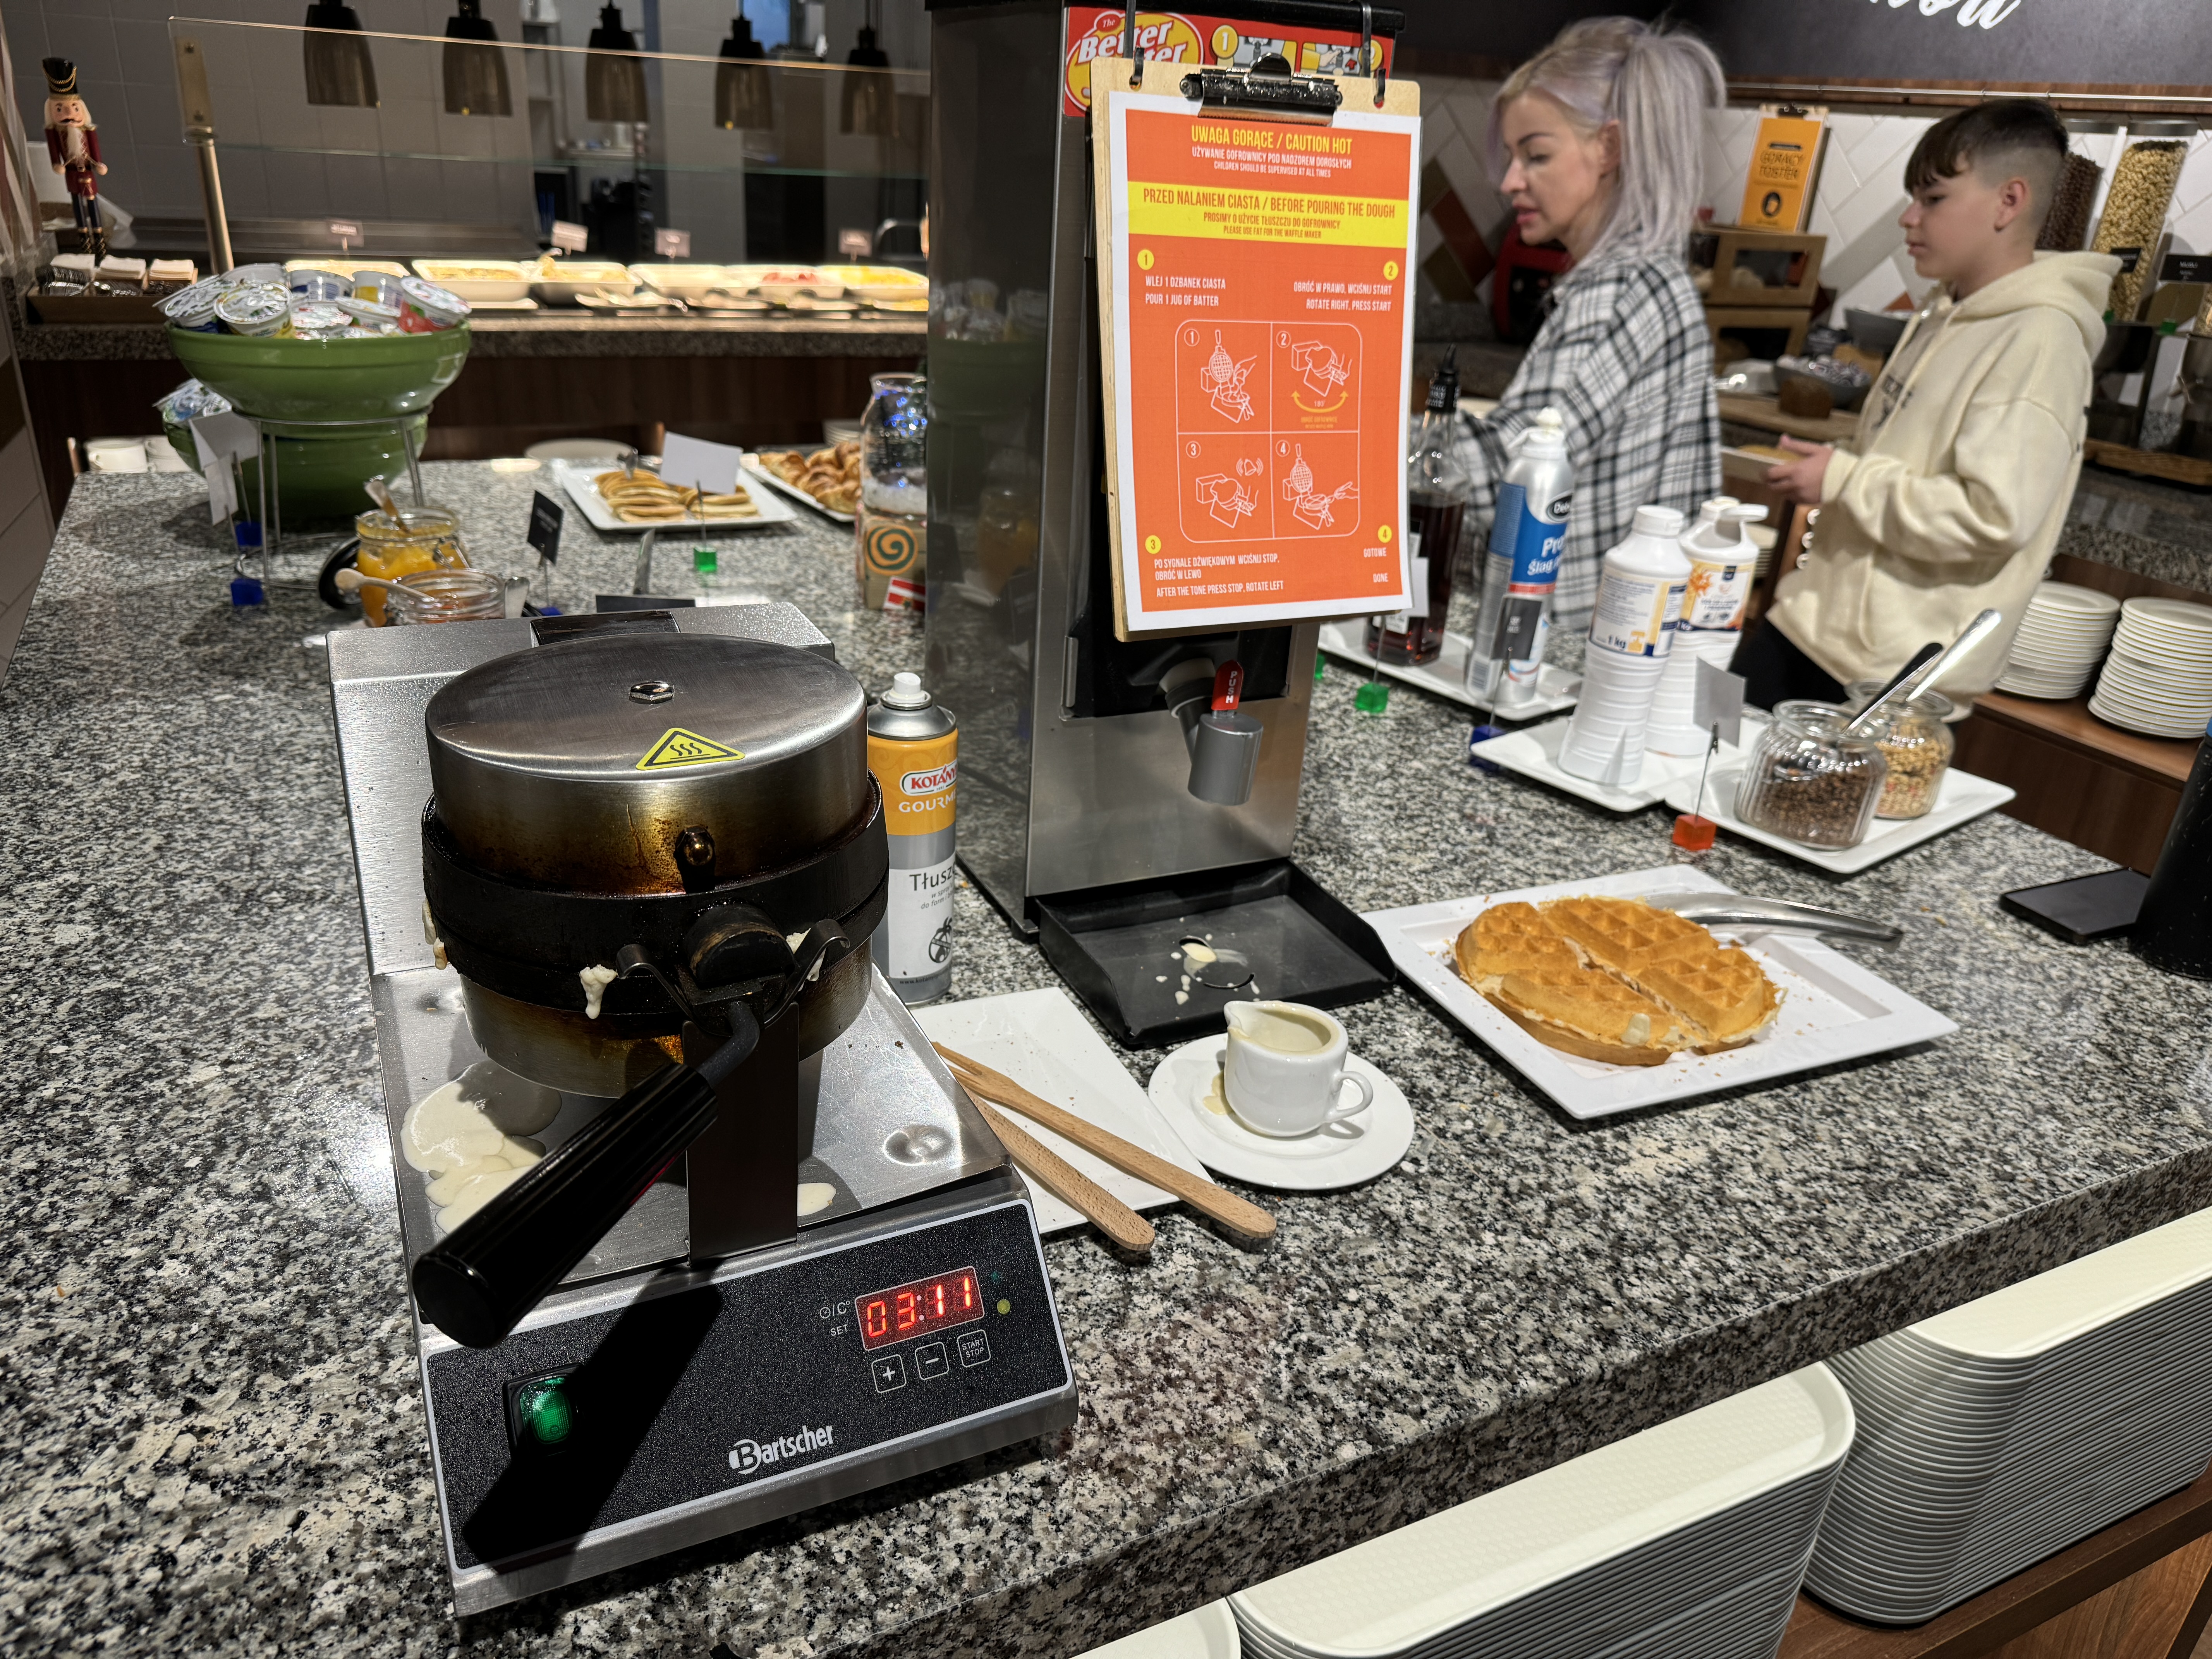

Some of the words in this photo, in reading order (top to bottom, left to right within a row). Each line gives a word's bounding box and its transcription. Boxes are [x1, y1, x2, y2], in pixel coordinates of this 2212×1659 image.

[1103, 19, 1115, 28] The
[1222, 32, 1229, 51] 1
[1192, 125, 1230, 145] UWAGA
[1233, 129, 1274, 150] GORĄCE
[1286, 133, 1330, 152] CAUTION
[1333, 138, 1352, 155] HOT
[1192, 145, 1225, 160] UŻYWANIE
[1226, 149, 1267, 162] GOFROWNICY
[1268, 153, 1280, 164] POD
[1281, 154, 1315, 166] NADZOREM
[1316, 156, 1352, 169] DOROSŁYCH
[1214, 161, 1239, 171] CHILDREN
[1240, 163, 1259, 172] SHOULD
[1260, 164, 1266, 173] BE
[1268, 165, 1298, 175] SUPERVISED
[1298, 167, 1305, 176] AT
[1305, 168, 1315, 177] ALL
[1316, 168, 1331, 178] TIMES
[1144, 188, 1174, 204] PRZED
[1177, 191, 1225, 208] NALANIEM
[1228, 194, 1259, 210] CIASTA
[1271, 197, 1304, 213] BEFORE
[1307, 199, 1345, 215] POURING
[1347, 202, 1364, 216] THE
[1366, 203, 1395, 218] DOUGH
[1204, 212, 1231, 223] PROSIMY
[1233, 214, 1237, 224] O
[1238, 213, 1259, 225] UŻYCIE
[1262, 215, 1291, 227] TŁUSZCZU
[1292, 217, 1301, 227] DO
[1302, 218, 1341, 230] GOFROWNICY
[1223, 225, 1242, 235] PLEASE
[1243, 226, 1252, 235] USE
[1253, 227, 1262, 235] FAT
[1264, 227, 1273, 236] FOR
[1274, 228, 1283, 237] THE
[1284, 229, 1303, 238] WAFFLE
[1304, 230, 1321, 239] MAKER
[1144, 253, 1148, 266] 1
[1388, 265, 1394, 276] 2
[1145, 275, 1163, 287] WLEJ
[1165, 276, 1168, 287] 1
[1170, 276, 1201, 289] DZBANEK
[1202, 278, 1226, 289] CIASTA
[1293, 280, 1315, 292] OBRÓĆ
[1316, 282, 1322, 293] W
[1373, 285, 1392, 295] START
[1145, 293, 1163, 304] POUR
[1166, 294, 1169, 304] 1
[1170, 294, 1182, 305] JUG
[1183, 295, 1192, 305] OF
[1194, 295, 1219, 306] BATTER
[1306, 299, 1330, 309] ROTATE
[1352, 300, 1371, 311] PRESS
[1372, 301, 1391, 311] START
[1190, 331, 1194, 344] 1
[1281, 333, 1286, 345] 2
[1191, 443, 1196, 456] 3
[1280, 442, 1286, 454] 4
[1382, 529, 1387, 539] 4
[1151, 539, 1156, 550] 3
[1364, 547, 1387, 558] GOTOWE
[1154, 558, 1163, 568] PO
[1164, 557, 1191, 568] SYGNALE
[1193, 555, 1235, 568] DŹWIĘKOWYM
[1238, 553, 1262, 564] WCIŚNIJ
[1155, 569, 1176, 581] OBRÓĆ
[1177, 570, 1183, 579] W
[1184, 569, 1201, 579] LEWO
[1373, 573, 1388, 583] DONE
[1157, 587, 1176, 597] AFTER
[1178, 586, 1189, 596] THE
[1190, 585, 1207, 595] TONE
[1207, 584, 1227, 594] PRESS
[1246, 581, 1269, 592] ROTATE
[1270, 580, 1283, 591] LEFT
[1225, 671, 1237, 704] PUSH
[931, 897, 944, 907] form
[866, 1276, 971, 1338] 03:11
[830, 1324, 848, 1336] SET
[962, 1338, 984, 1350] START
[966, 1347, 984, 1358] STOP
[729, 1425, 833, 1474] Bartscher
